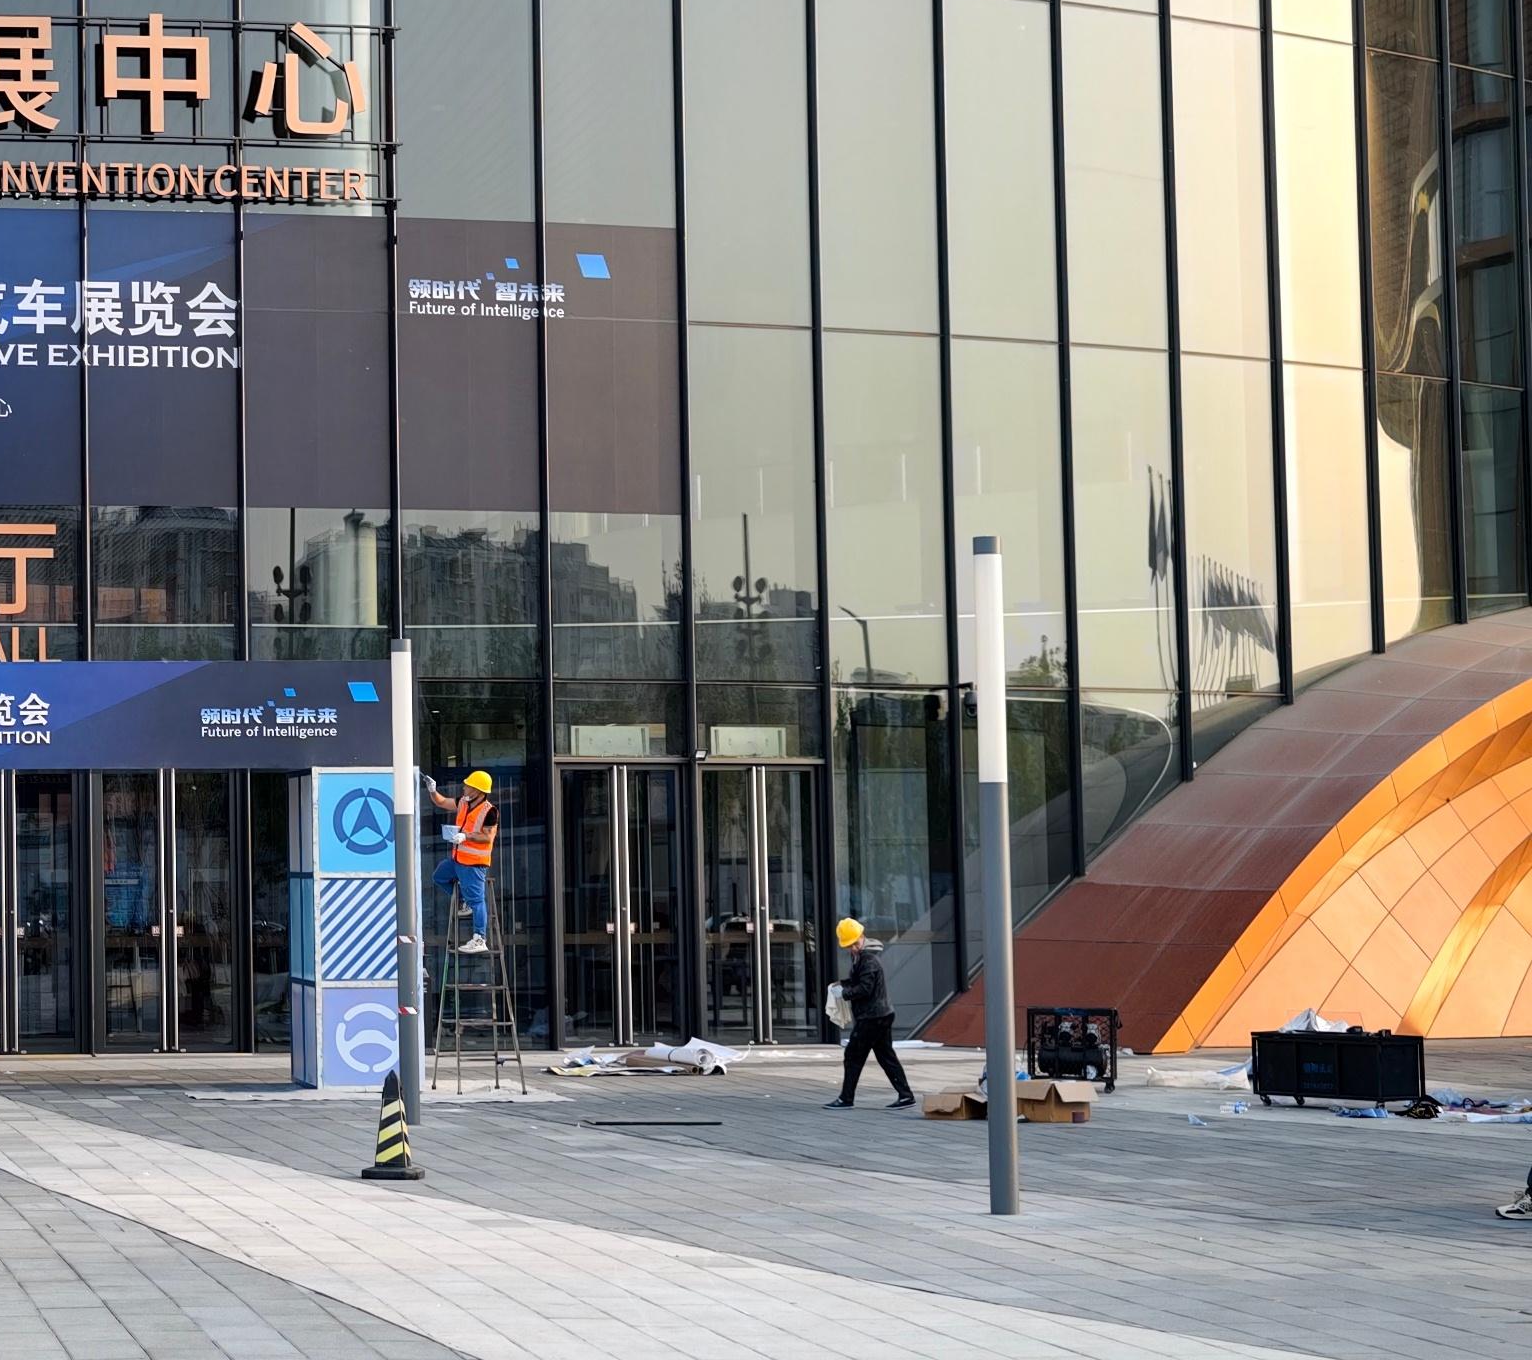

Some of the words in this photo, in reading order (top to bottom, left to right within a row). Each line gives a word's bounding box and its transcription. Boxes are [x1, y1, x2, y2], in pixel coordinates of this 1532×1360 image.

[213, 164, 367, 201] CENTER
[408, 279, 482, 301] 领时代
[494, 281, 566, 303] 智未来
[408, 301, 456, 316] Future
[461, 302, 477, 316] of
[48, 343, 242, 369] EXHIBITION
[201, 706, 264, 725] 领时代
[275, 707, 338, 724] 智未来
[201, 726, 242, 738] Future
[245, 726, 259, 738] of
[263, 726, 338, 739] Intelligence
